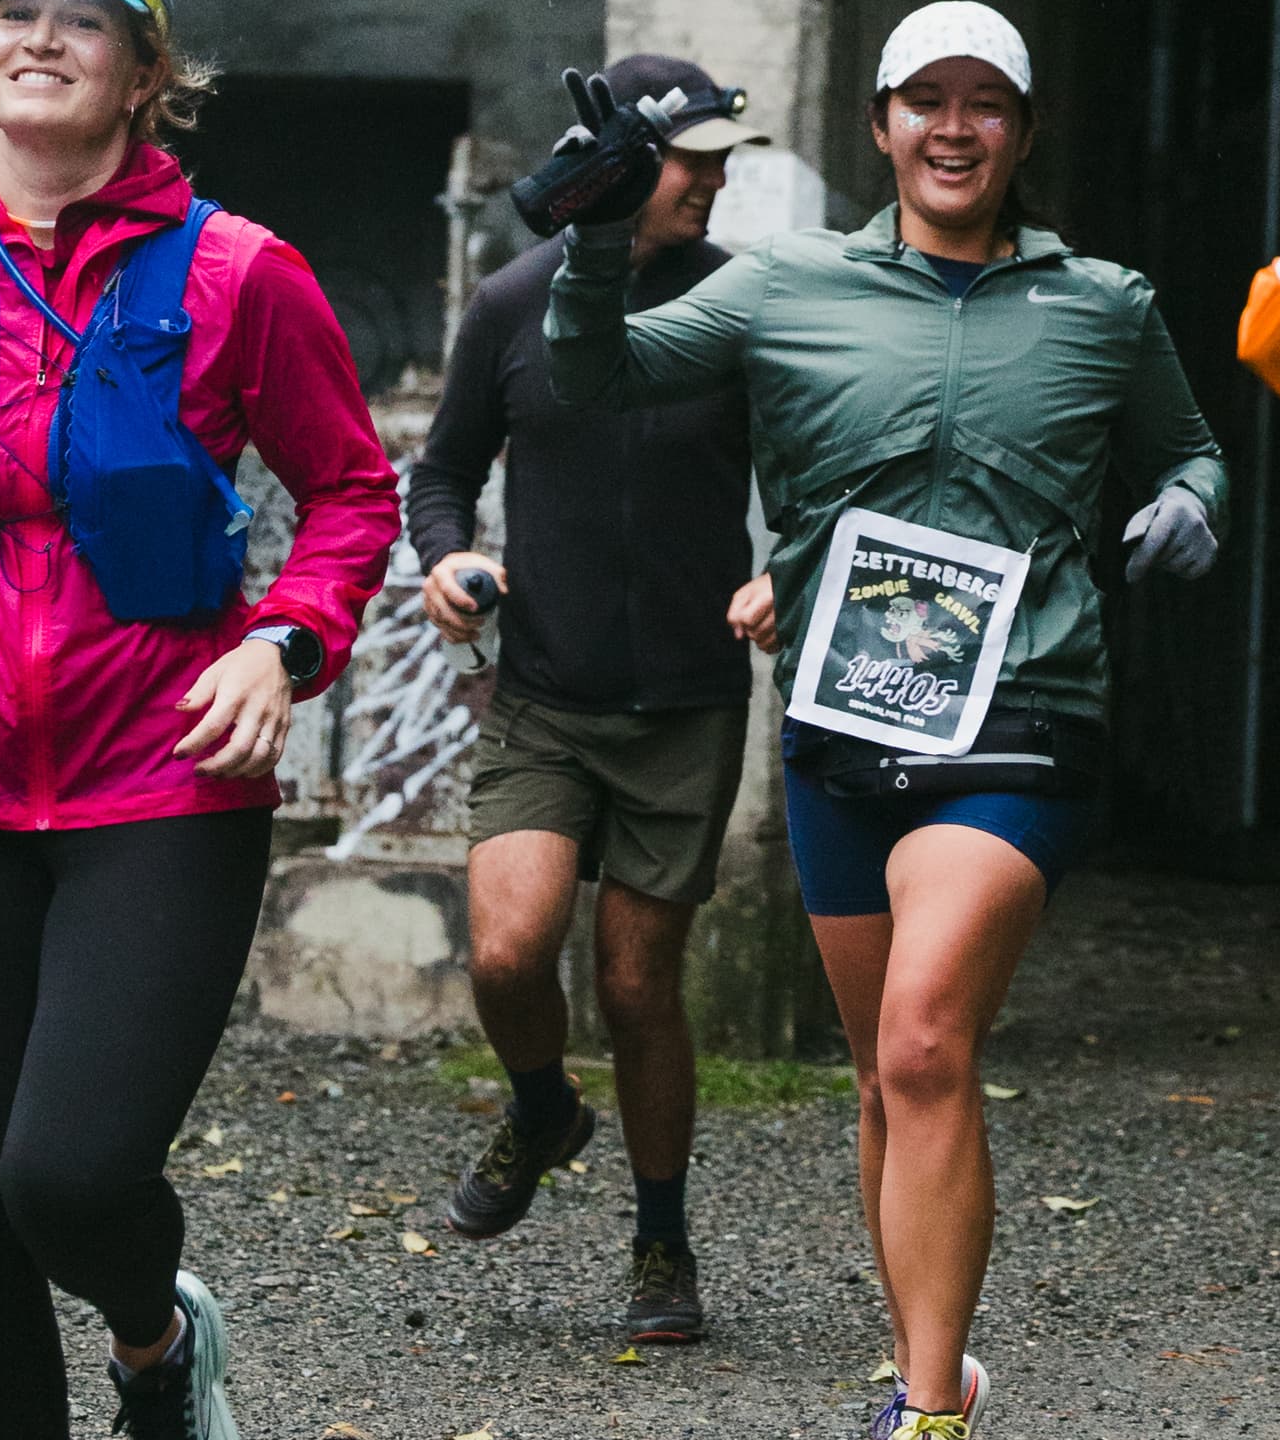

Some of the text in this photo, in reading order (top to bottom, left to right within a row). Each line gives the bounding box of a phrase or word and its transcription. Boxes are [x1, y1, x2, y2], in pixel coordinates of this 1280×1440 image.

[853, 550, 1001, 602] ZETTERBERG
[848, 579, 981, 635] ZOMBIE CRAWL
[835, 653, 959, 716] 14405
